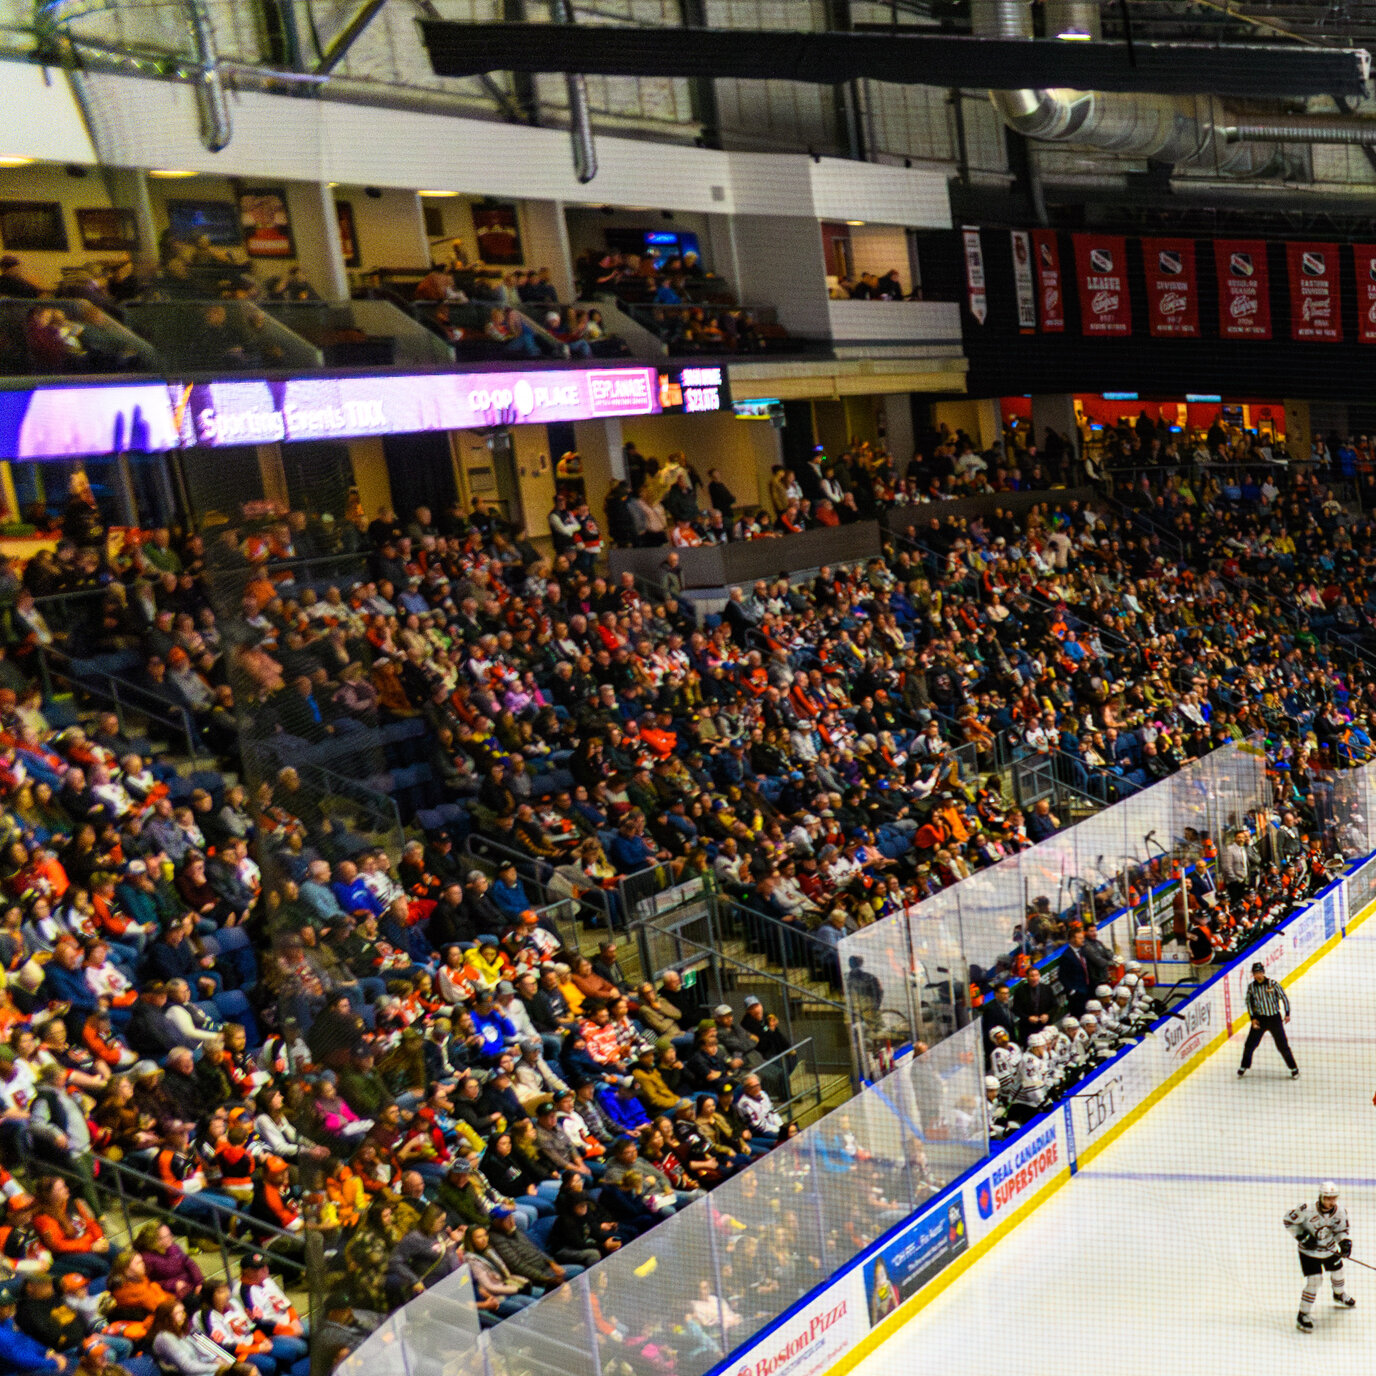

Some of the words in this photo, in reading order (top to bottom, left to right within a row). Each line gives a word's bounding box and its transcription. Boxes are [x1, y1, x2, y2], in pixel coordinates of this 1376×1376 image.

[1163, 1021, 1184, 1053] Sun
[1184, 1000, 1213, 1041] Valley
[992, 1162, 1013, 1188] REAL
[1014, 1124, 1057, 1168] CANADIAN
[994, 1142, 1059, 1211] SUPERSTORE
[809, 1298, 848, 1342] Pizza
